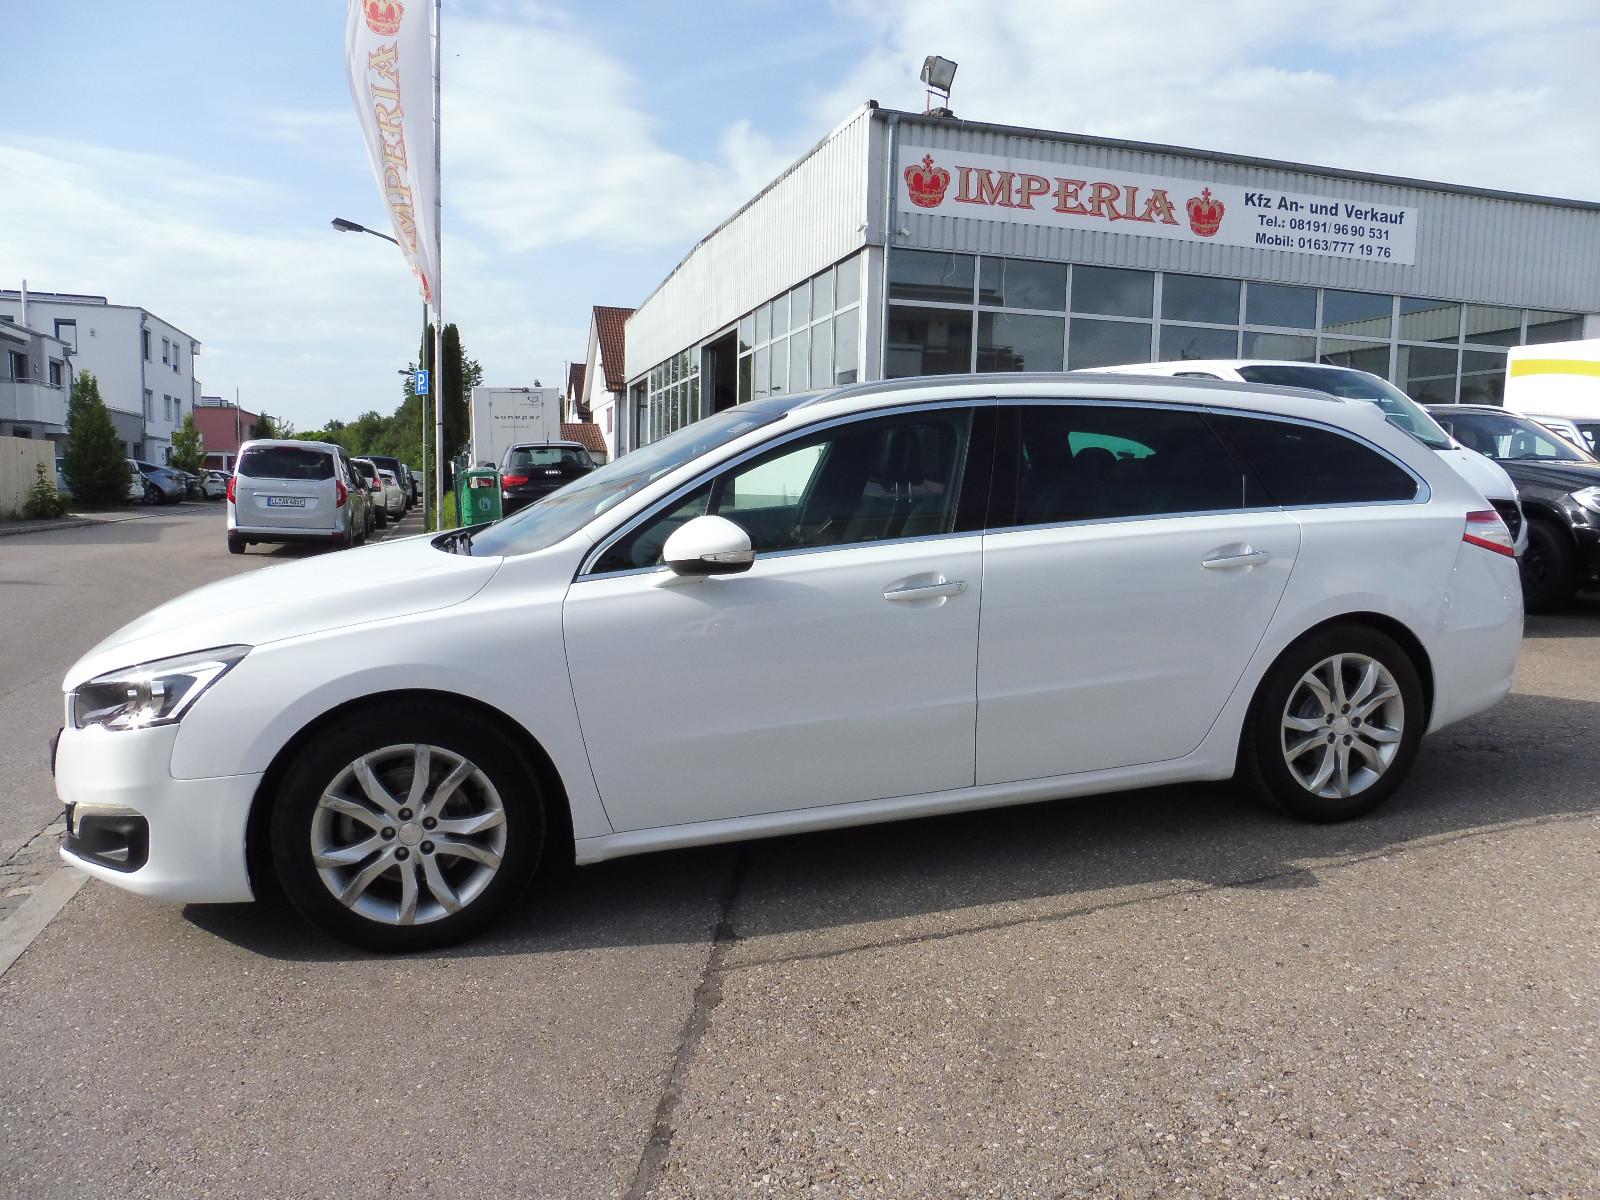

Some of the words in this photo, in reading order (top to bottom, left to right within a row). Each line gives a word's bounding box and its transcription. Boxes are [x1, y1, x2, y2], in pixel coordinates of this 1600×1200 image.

[368, 40, 417, 252] MPERIA
[953, 165, 1181, 226] IMPERIA
[1244, 192, 1272, 209] Kfz
[1277, 196, 1304, 212] An-
[1309, 202, 1339, 217] und
[1344, 203, 1405, 225] Verkauf
[1258, 214, 1285, 228] Tel.:
[1368, 228, 1390, 241] 531
[1255, 232, 1294, 247] Mobil:
[1298, 237, 1355, 254] 0163/777
[418, 373, 425, 391] P
